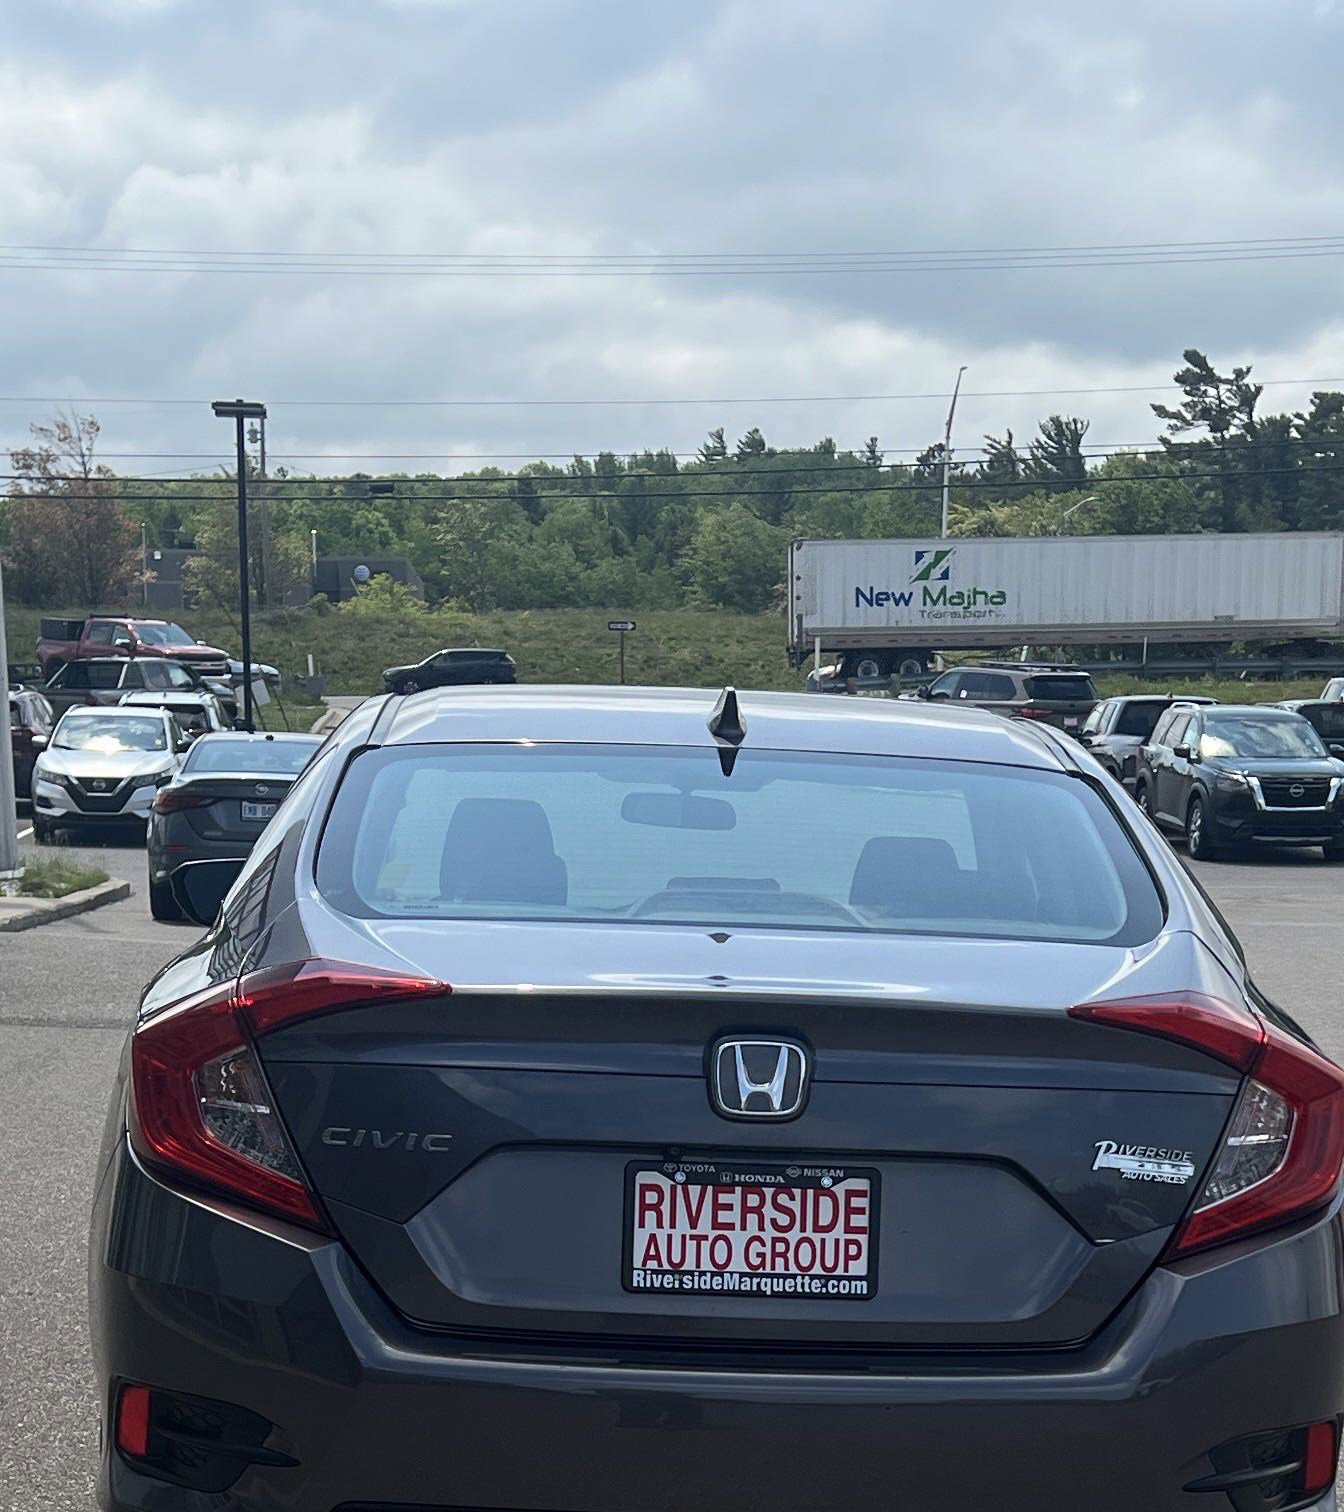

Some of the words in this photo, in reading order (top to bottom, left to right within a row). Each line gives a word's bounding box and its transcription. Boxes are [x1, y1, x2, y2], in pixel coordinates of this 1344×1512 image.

[855, 586, 913, 608] New
[922, 585, 1007, 610] Majha
[321, 1127, 453, 1151] CIVIC
[1093, 1140, 1193, 1168] RIVERSIDE
[678, 1164, 716, 1173] TOYOTA
[734, 1174, 786, 1184] HONDA
[803, 1168, 844, 1178] NISSAN
[1122, 1171, 1152, 1181] AUTO
[1154, 1174, 1186, 1184] SALES
[638, 1183, 868, 1235] RIVERSIDE
[641, 1233, 733, 1271] AUTO
[743, 1236, 863, 1274] GROUP
[632, 1269, 868, 1295] RiversideMarquette.com
